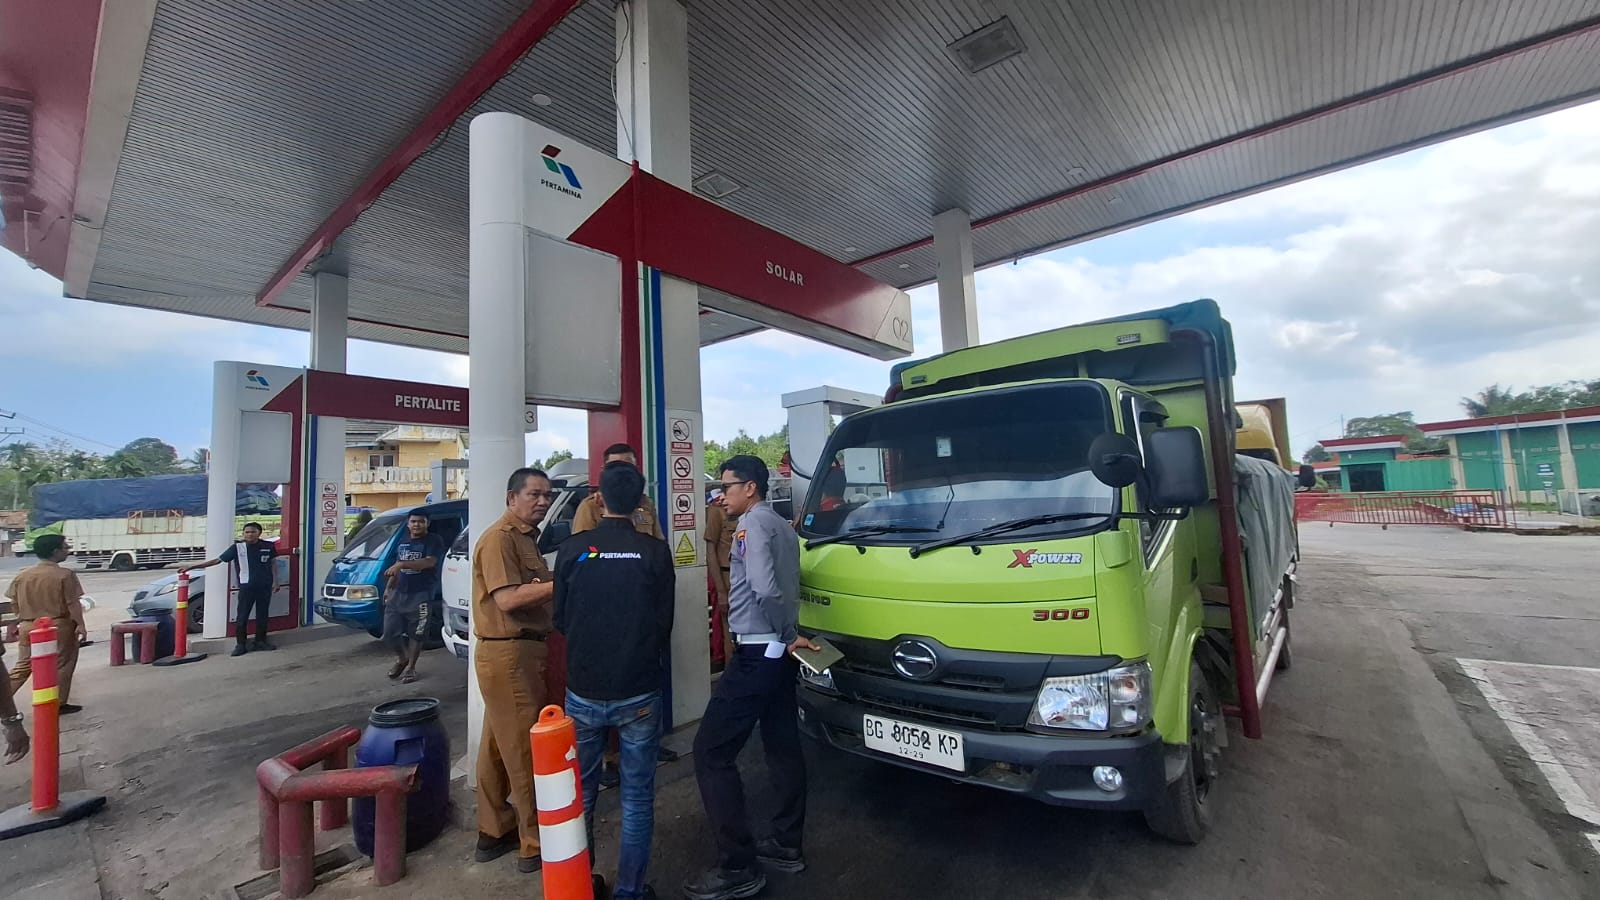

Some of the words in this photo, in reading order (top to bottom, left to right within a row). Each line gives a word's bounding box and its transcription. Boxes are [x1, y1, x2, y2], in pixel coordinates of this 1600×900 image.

[540, 178, 582, 200] PERTAMINA
[765, 260, 804, 287] SOLAR
[892, 316, 911, 343] 02
[395, 394, 461, 412] PERTALITE
[1032, 608, 1090, 622] 300
[865, 718, 884, 740] BG
[891, 721, 932, 751] 8052
[937, 733, 959, 757] KP
